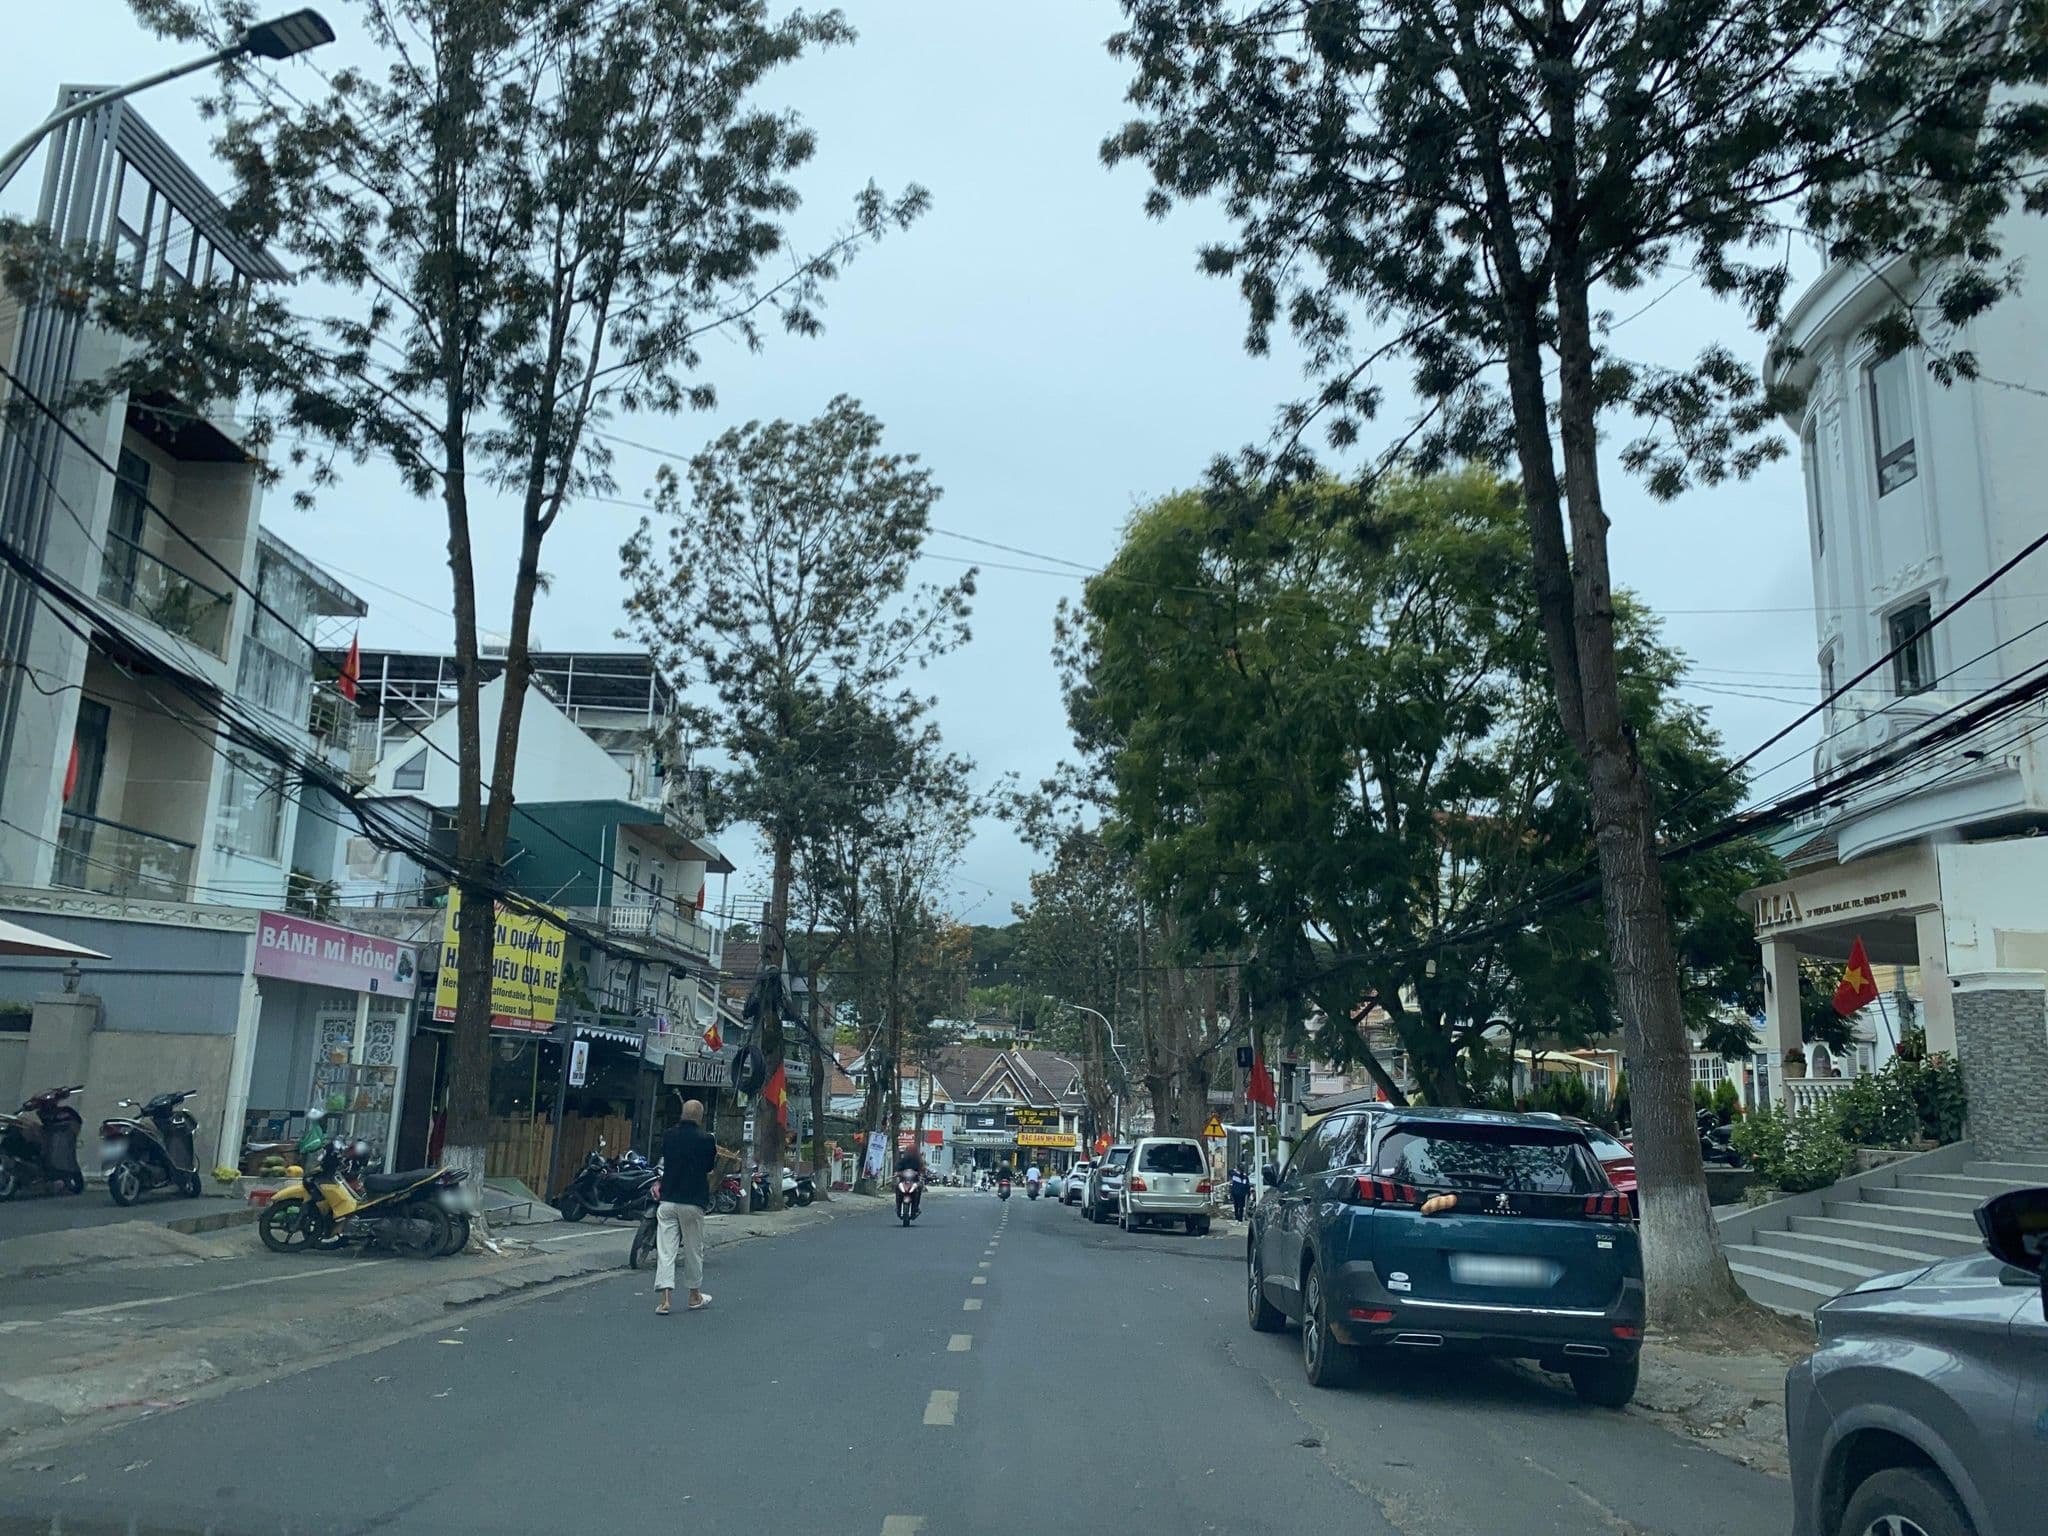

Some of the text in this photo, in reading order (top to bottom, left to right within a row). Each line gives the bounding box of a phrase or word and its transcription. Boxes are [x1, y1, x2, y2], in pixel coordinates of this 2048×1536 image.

[261, 925, 394, 971] BÁNH MÌ HỒNG
[544, 966, 558, 989] RẺ
